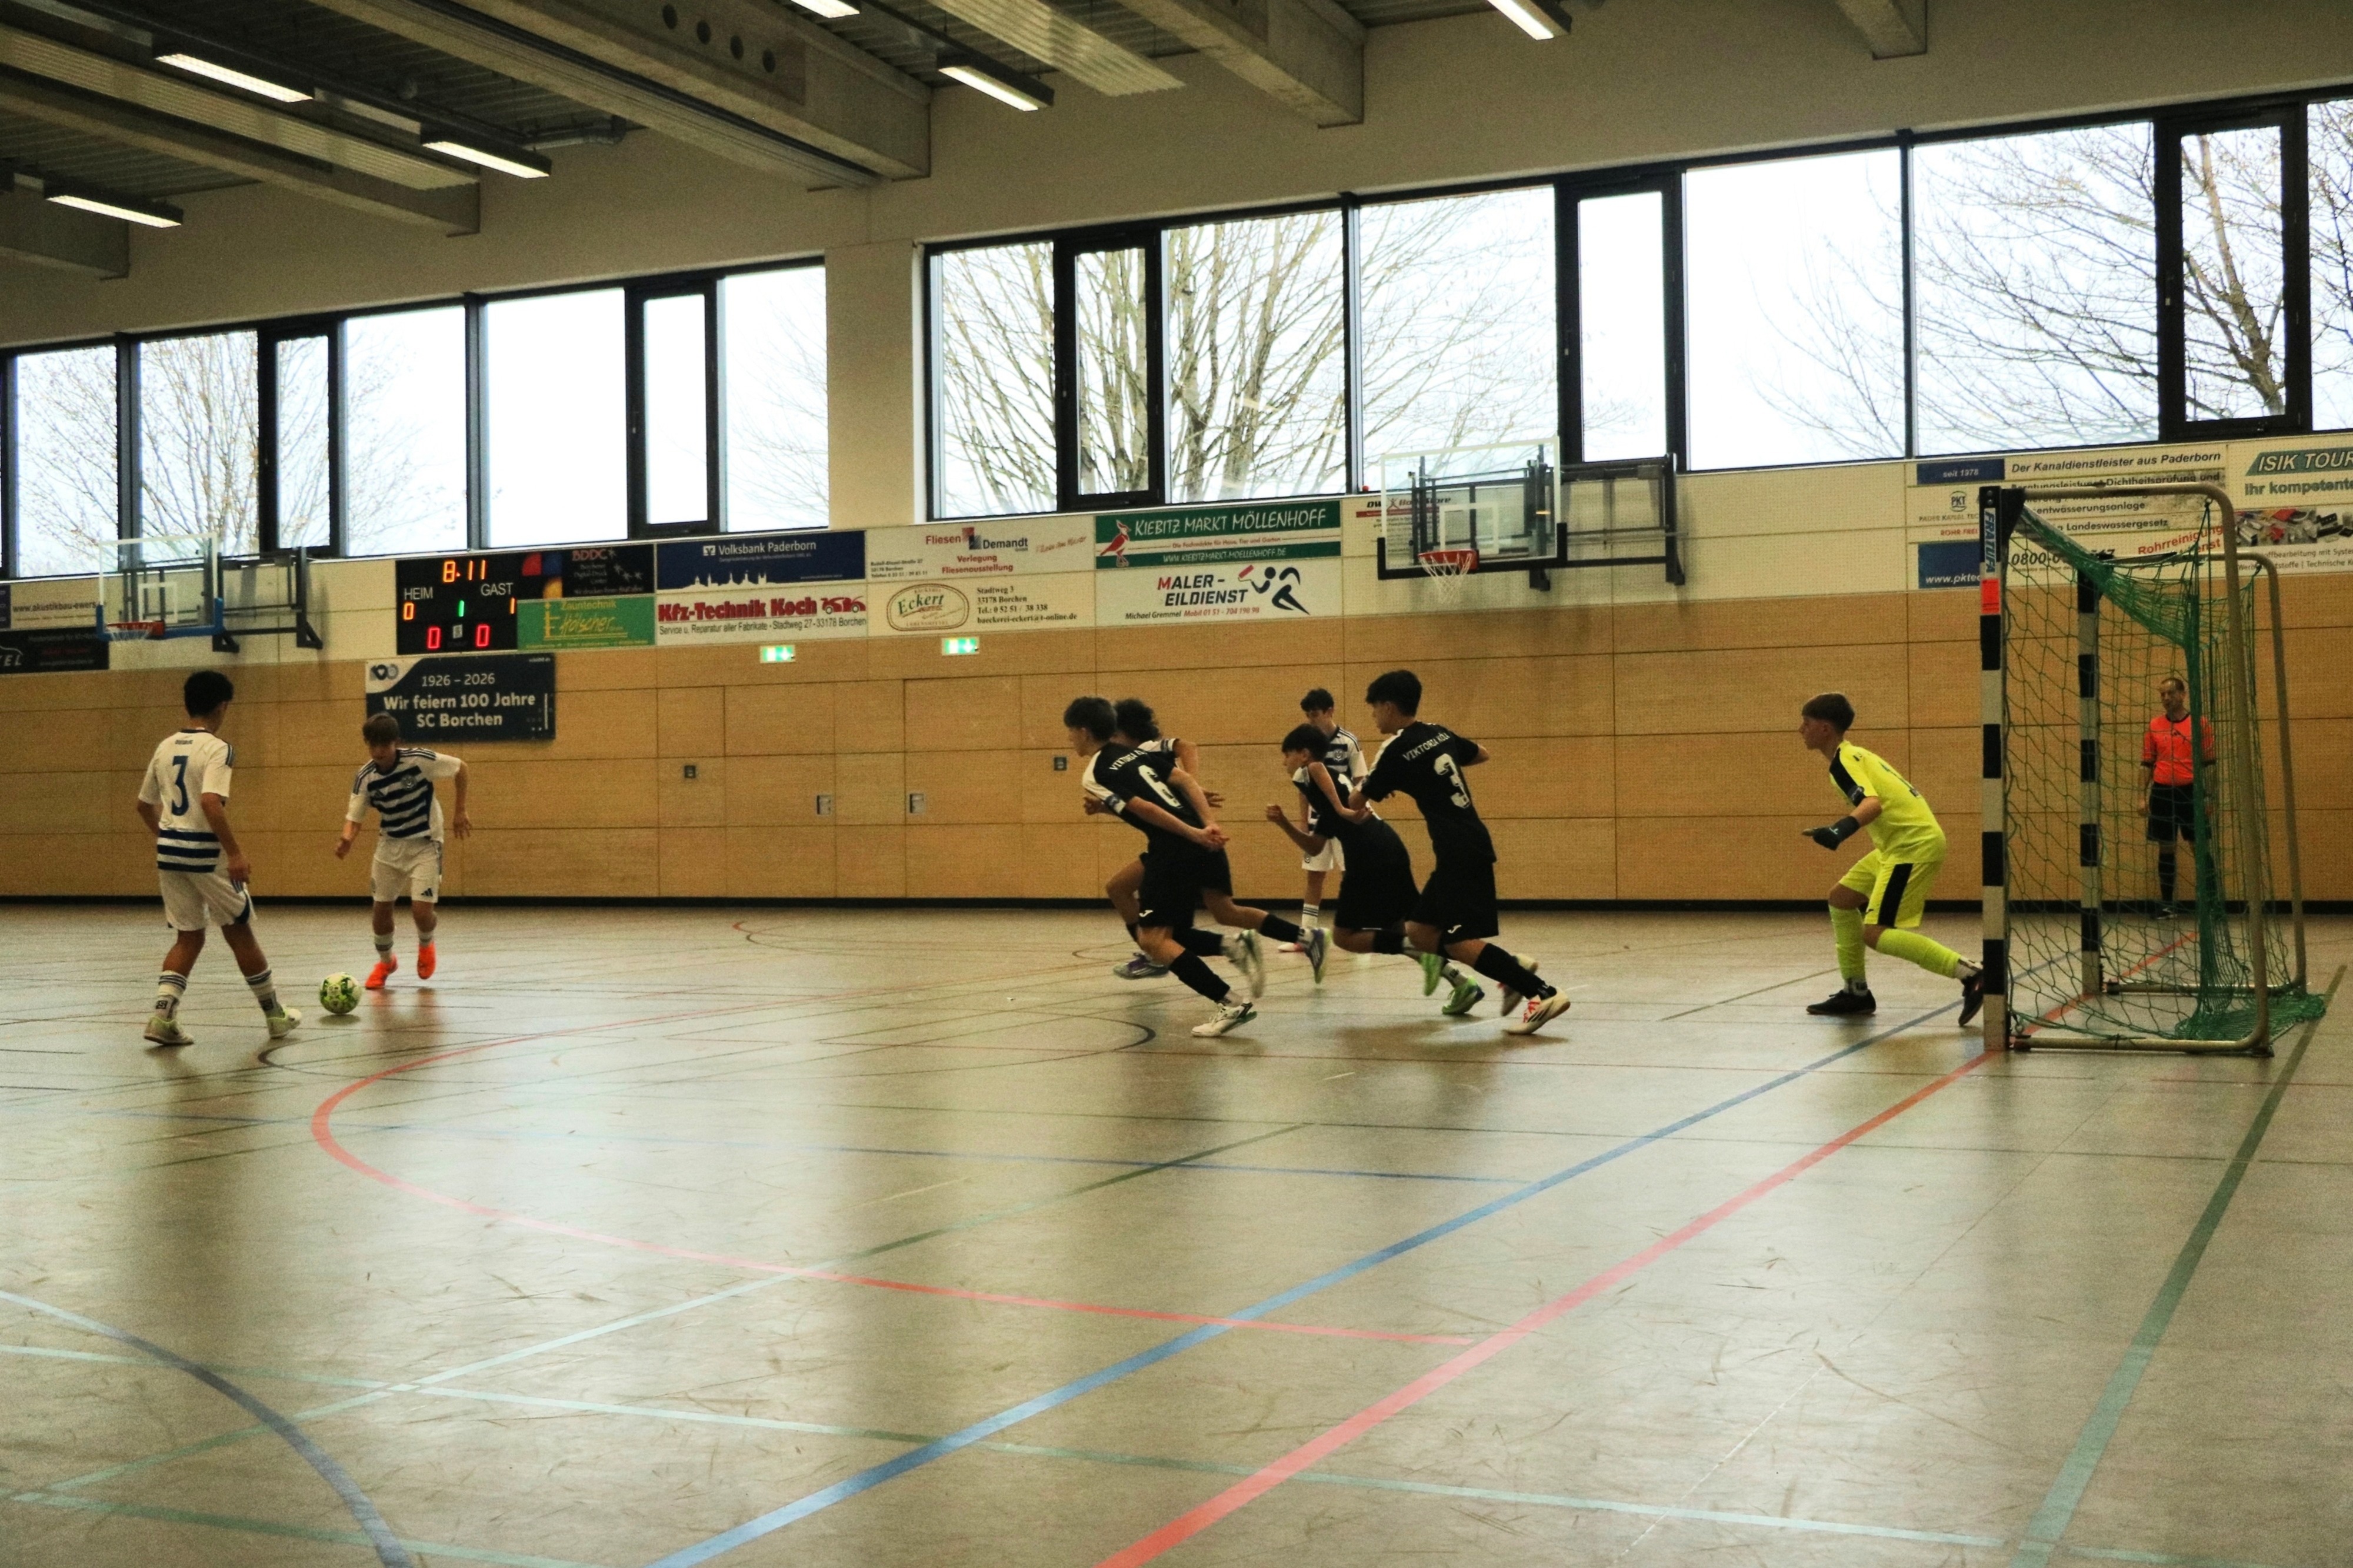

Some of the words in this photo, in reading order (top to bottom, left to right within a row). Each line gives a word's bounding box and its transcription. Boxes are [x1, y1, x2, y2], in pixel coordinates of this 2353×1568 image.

[2012, 463, 2029, 473] Der
[2034, 458, 2134, 471] Kanaldienstleister
[2161, 452, 2221, 464] Paderborn
[2258, 455, 2298, 471] ISIK
[2200, 473, 2219, 481] und
[2245, 483, 2265, 496] Ihr
[1951, 496, 1965, 506] PKT
[1135, 519, 1180, 536] KIEBITZ
[1185, 516, 1228, 532] MARKT
[1232, 509, 1326, 530] MÖLLENHOFF
[2067, 519, 2168, 531] Landeswassergesetz
[719, 543, 765, 556] Volksbank
[768, 541, 816, 553] Paderborn
[926, 535, 961, 545] Fliesen
[983, 538, 1028, 549] Demandt
[1985, 511, 1996, 573] FRATUFA
[957, 555, 998, 563] Verlegung
[942, 564, 1014, 573] Fliesenausstellung
[481, 582, 514, 596] GAST
[1157, 575, 1214, 590] MALER
[404, 587, 434, 600] HEIM
[1165, 589, 1248, 606] EILDIENST
[404, 602, 414, 620] 0
[458, 600, 465, 617] 1
[510, 597, 515, 614] 1
[561, 600, 616, 610] Zauntechnik
[658, 599, 766, 622] Kfz-Technik
[771, 596, 817, 617] Koch
[898, 594, 945, 615] Eckert
[1125, 611, 1151, 619] Michael
[659, 625, 682, 636] Service
[692, 624, 722, 634] Reparatur
[723, 623, 737, 632] aller
[738, 620, 767, 631] Fabrikate
[773, 620, 803, 631] Stadtweg
[839, 617, 866, 627] Borchen
[428, 627, 441, 649] 0
[476, 625, 489, 646] 0
[422, 675, 451, 686] 1926
[464, 673, 495, 685] 2026
[384, 696, 409, 710] Wir
[413, 695, 456, 709] feiern
[460, 694, 489, 708] 100
[494, 692, 535, 707] Jahre
[416, 713, 435, 728] SC
[441, 713, 502, 727] Borchen
[171, 755, 189, 816] 3
[1138, 765, 1184, 809] 6
[1434, 753, 1470, 809] 3
